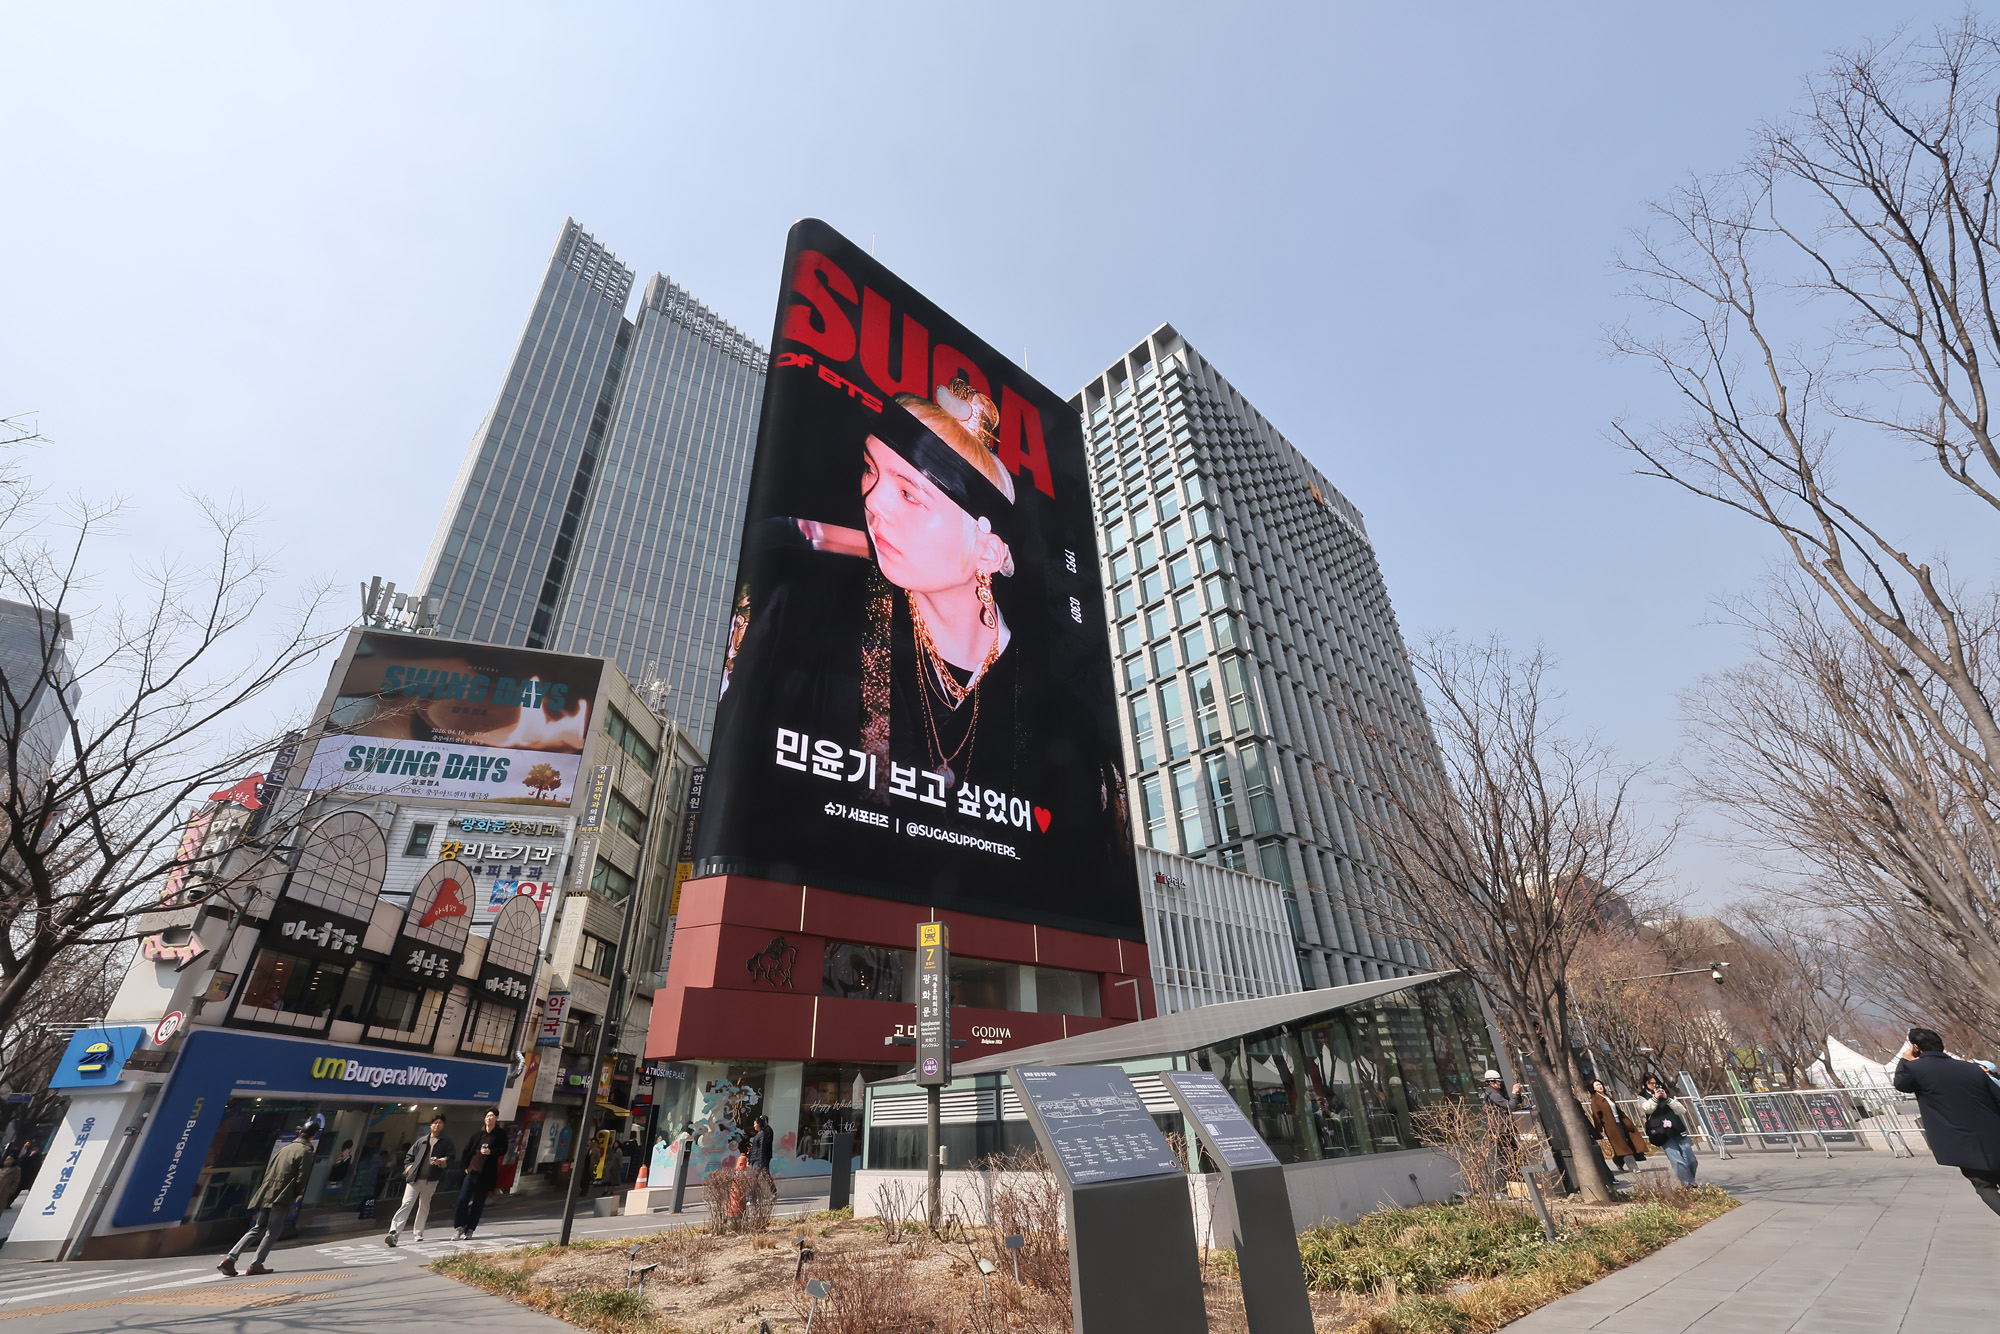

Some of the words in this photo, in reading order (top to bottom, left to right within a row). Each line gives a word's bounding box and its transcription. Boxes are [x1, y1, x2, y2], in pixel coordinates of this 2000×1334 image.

[817, 364, 884, 414] BTS
[1064, 548, 1077, 574] 1993
[1069, 596, 1083, 624] 0309
[380, 664, 491, 706] SWING
[491, 676, 569, 712] DAYS
[343, 744, 441, 778] SWING
[441, 752, 511, 783] DAYS
[345, 782, 365, 791] 2026.
[426, 787, 467, 799] 충무아트센터
[689, 774, 705, 809] 한의원
[774, 726, 877, 791] 민윤기
[888, 760, 947, 808] 보고
[956, 781, 1032, 832] 싶었어
[823, 801, 847, 819] 슈가
[847, 804, 889, 829] 서포터즈
[905, 820, 1021, 860] @SUGASUPPORTERS_
[439, 840, 556, 866] 강비뇨기과
[485, 864, 543, 881] 피부과
[281, 919, 358, 954] 마녀김밥
[406, 949, 449, 979] 청담동
[926, 948, 935, 961] 7
[485, 976, 527, 1000] 마녀김밥
[921, 973, 931, 1018] 광화문
[162, 1017, 177, 1038] 30
[543, 997, 566, 1036] 약국
[971, 1025, 1012, 1039] GODIVA
[645, 1066, 650, 1075] A
[650, 1067, 673, 1079] TWOSOME
[672, 1071, 686, 1081] PLACE
[41, 1116, 96, 1216] 움버거앤윙스
